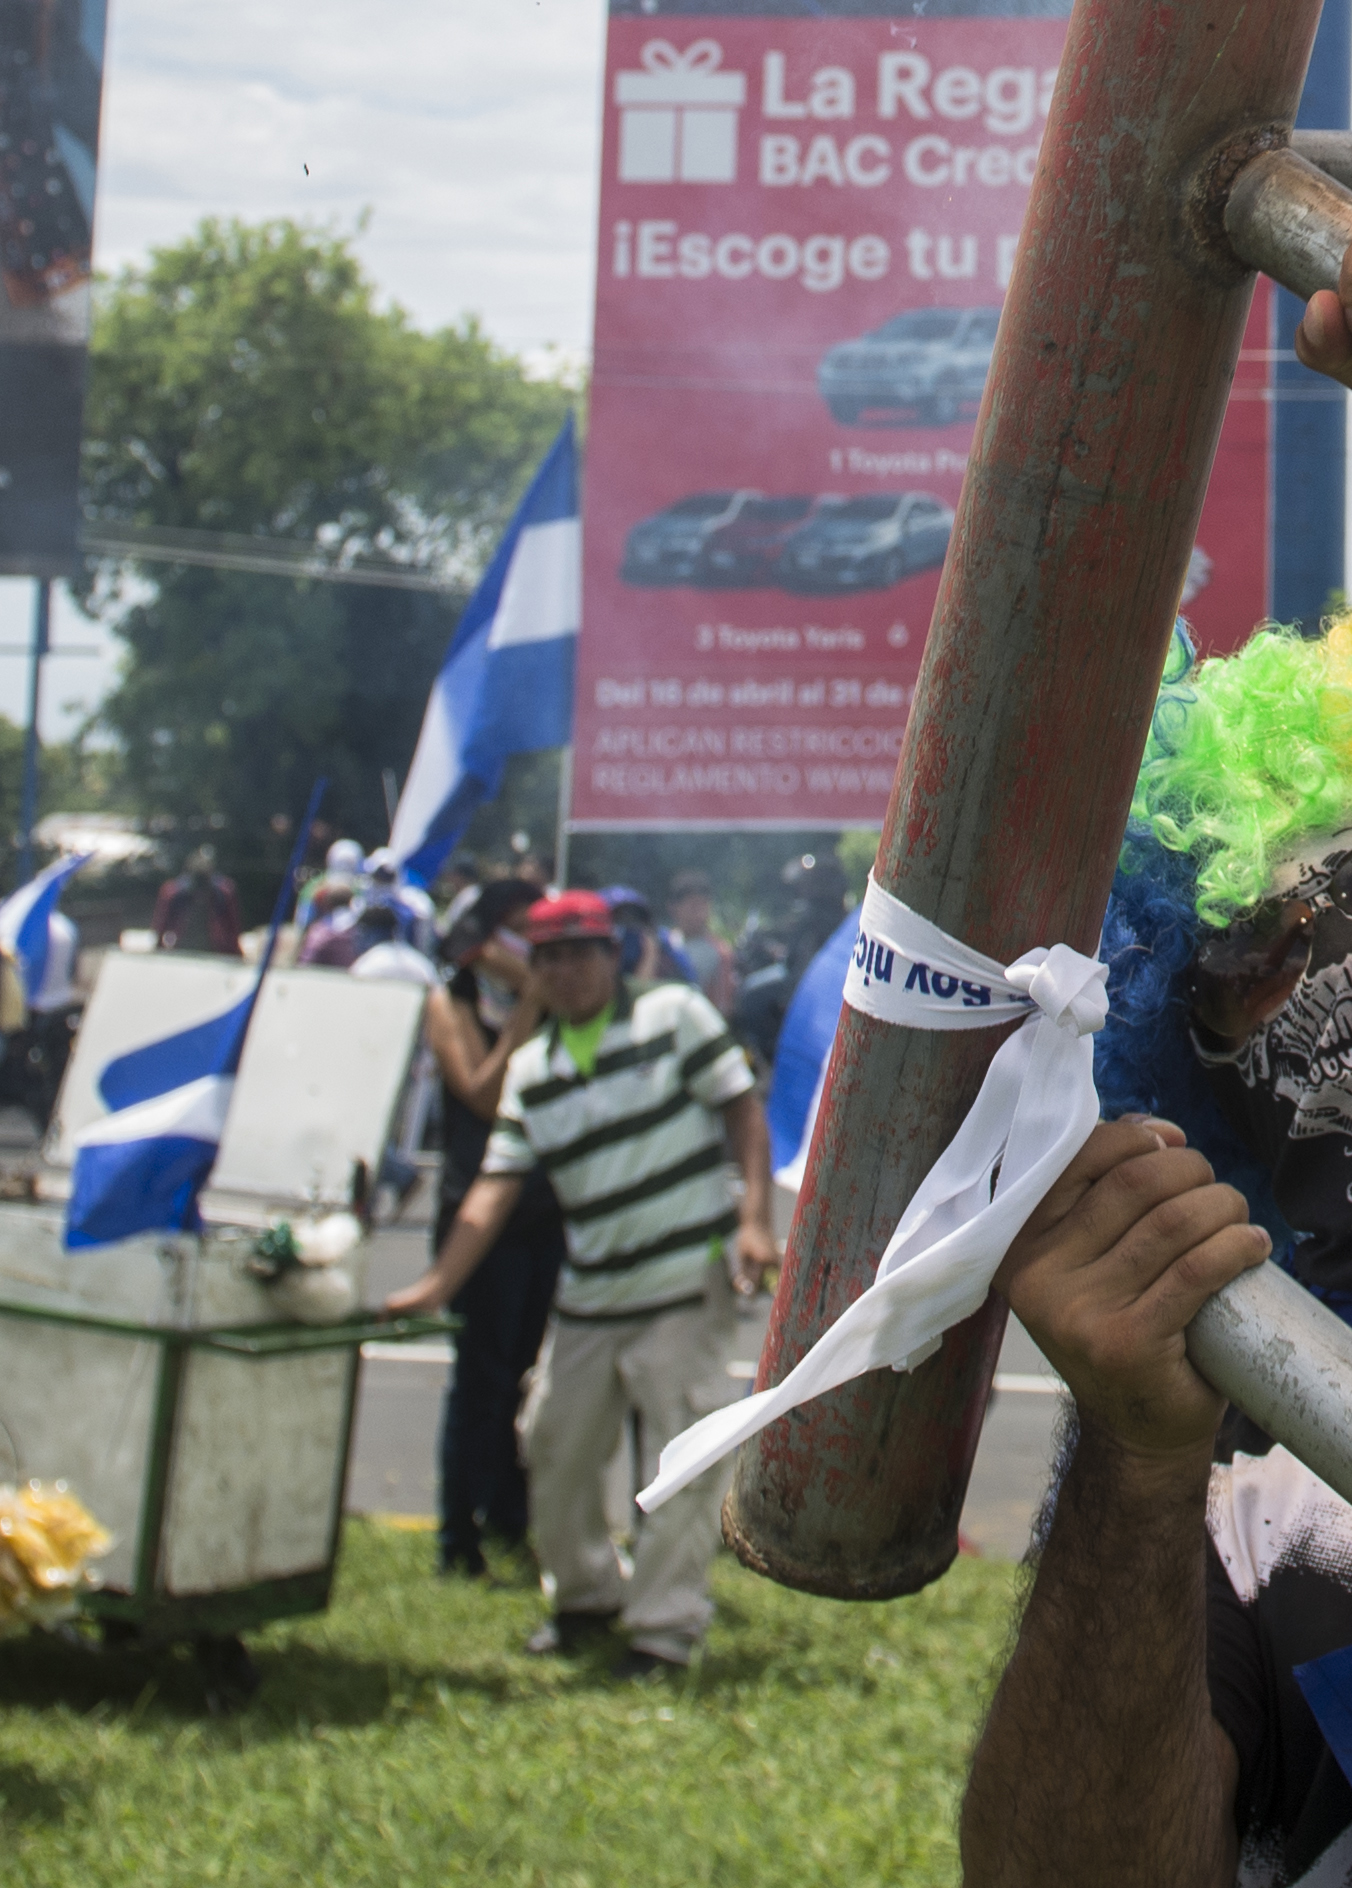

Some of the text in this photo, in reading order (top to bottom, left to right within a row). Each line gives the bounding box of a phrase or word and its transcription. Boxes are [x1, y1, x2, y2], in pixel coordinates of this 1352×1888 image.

[763, 51, 856, 119] La
[760, 134, 892, 188] BAC
[906, 228, 976, 280] tu
[848, 447, 931, 478] Toyota
[719, 622, 800, 654] Toyota
[803, 623, 866, 652] Yaris
[597, 678, 645, 708] Del
[687, 678, 725, 708] de
[729, 677, 793, 708] abril
[799, 679, 826, 708] al
[864, 678, 902, 708] de
[595, 726, 728, 758] APLICAN
[592, 764, 801, 795] REGLAMENTO
[852, 926, 895, 988] nic
